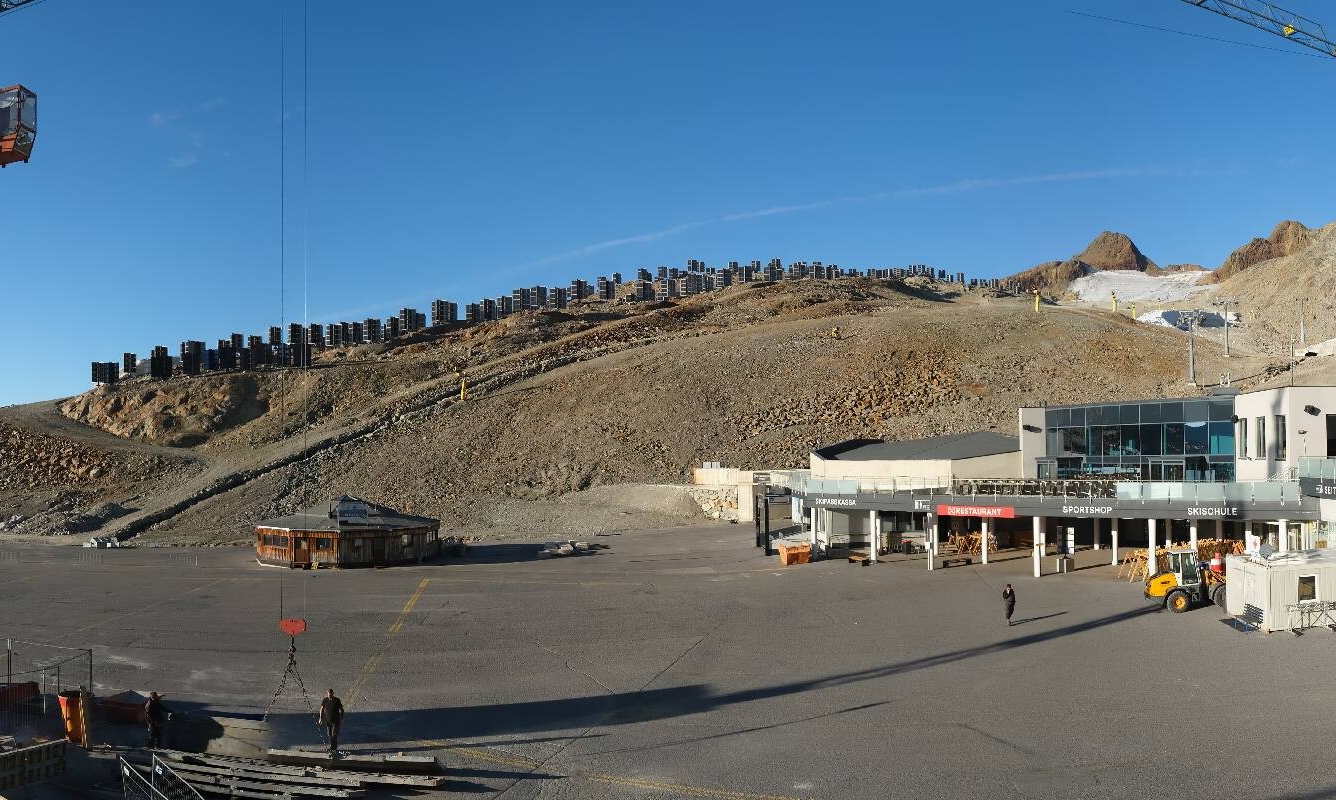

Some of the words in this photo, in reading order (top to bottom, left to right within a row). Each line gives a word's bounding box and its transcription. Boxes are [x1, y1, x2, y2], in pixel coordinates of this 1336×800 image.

[956, 507, 1002, 516] RESTAURANT
[1062, 505, 1113, 515] SPORTSHOP
[1187, 507, 1238, 516] SKISCHULE
